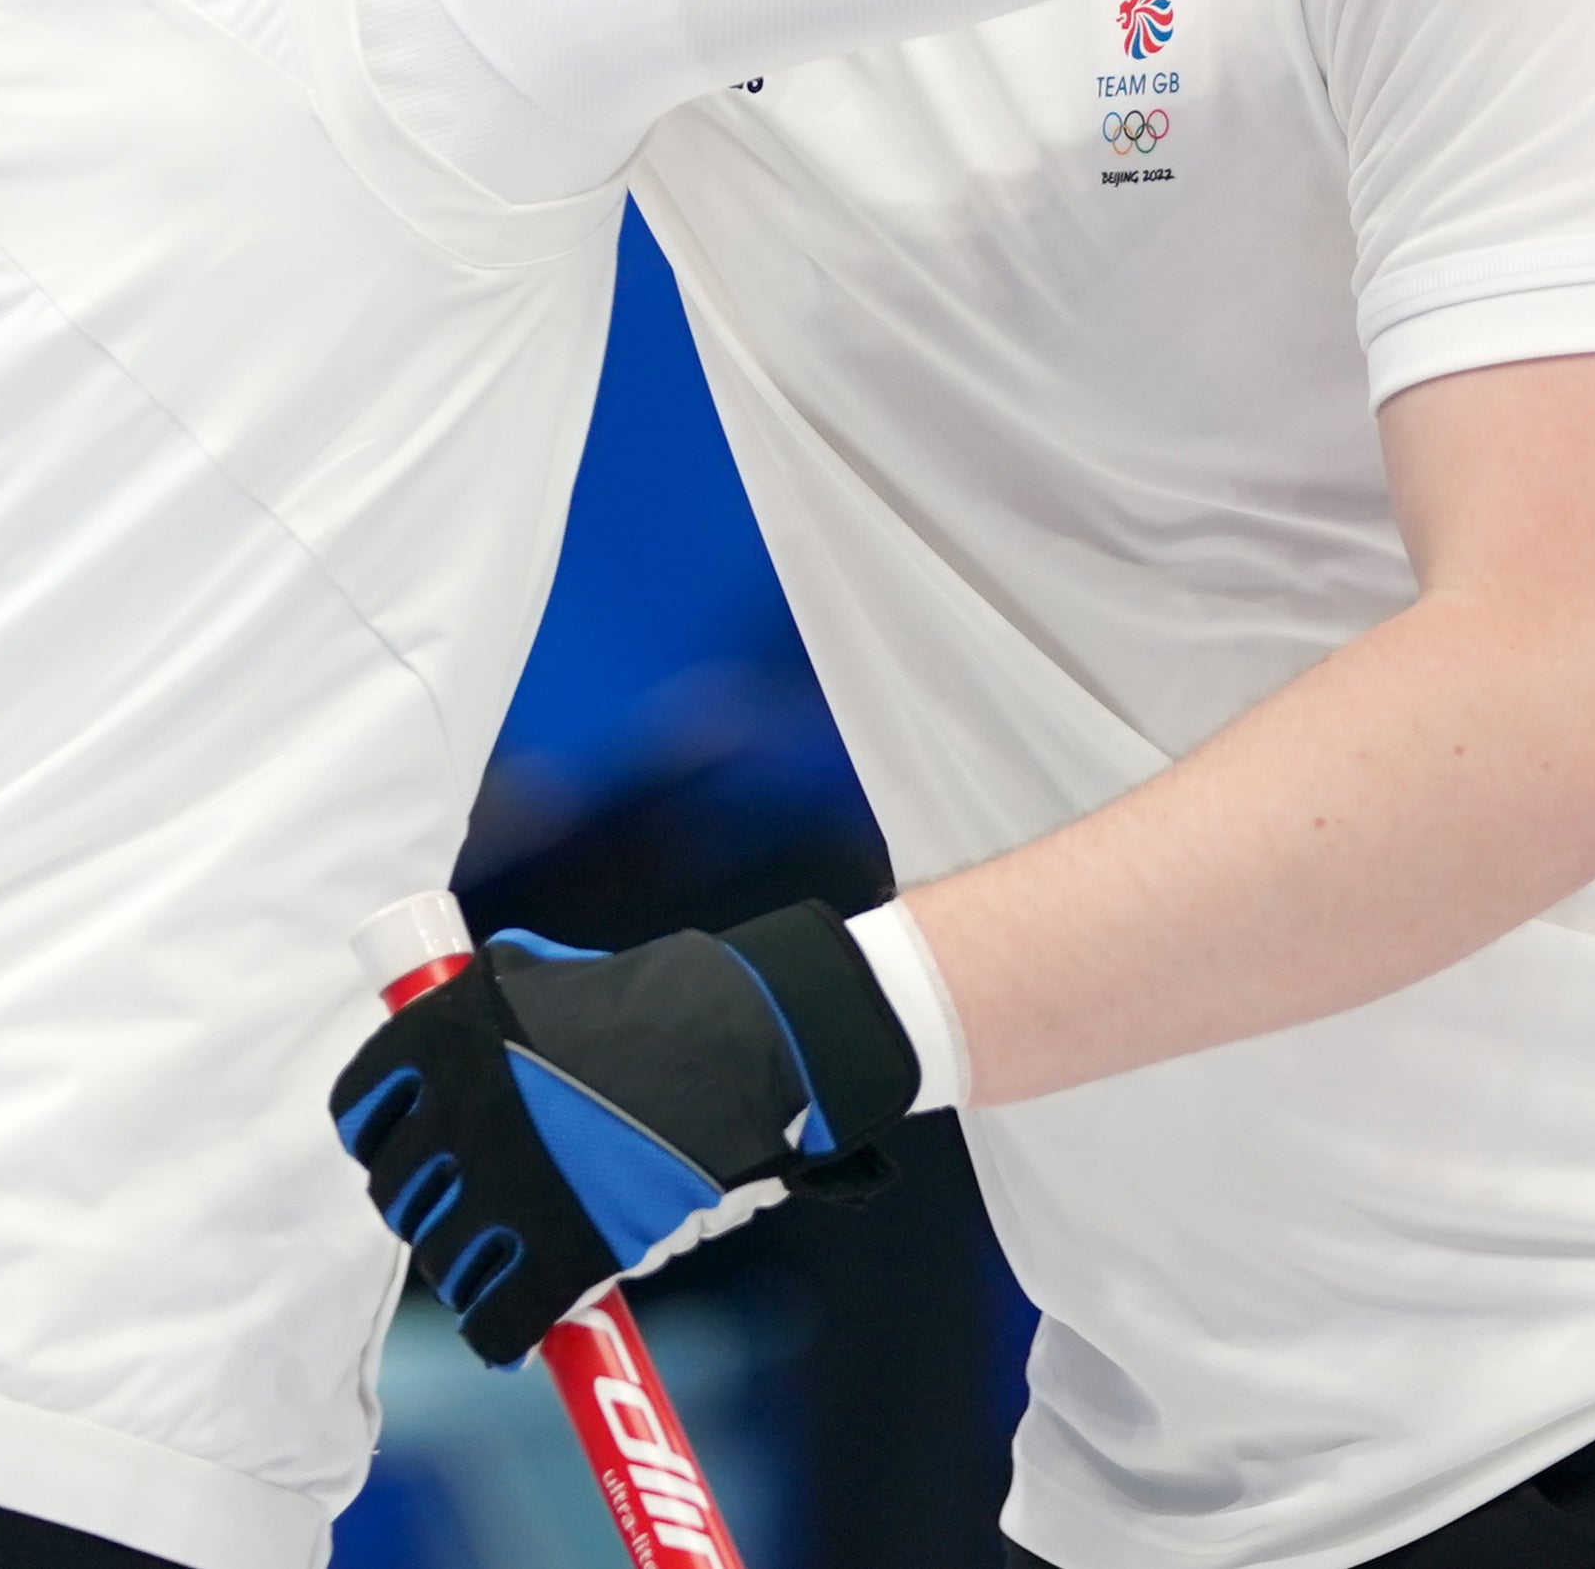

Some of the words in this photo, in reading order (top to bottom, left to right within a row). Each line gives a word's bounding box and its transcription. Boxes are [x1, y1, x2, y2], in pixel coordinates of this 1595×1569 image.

[1097, 73, 1146, 98] TEAM
[1152, 72, 1180, 94] GB
[1101, 170, 1139, 187] BEIJING
[1142, 168, 1175, 182] 2022
